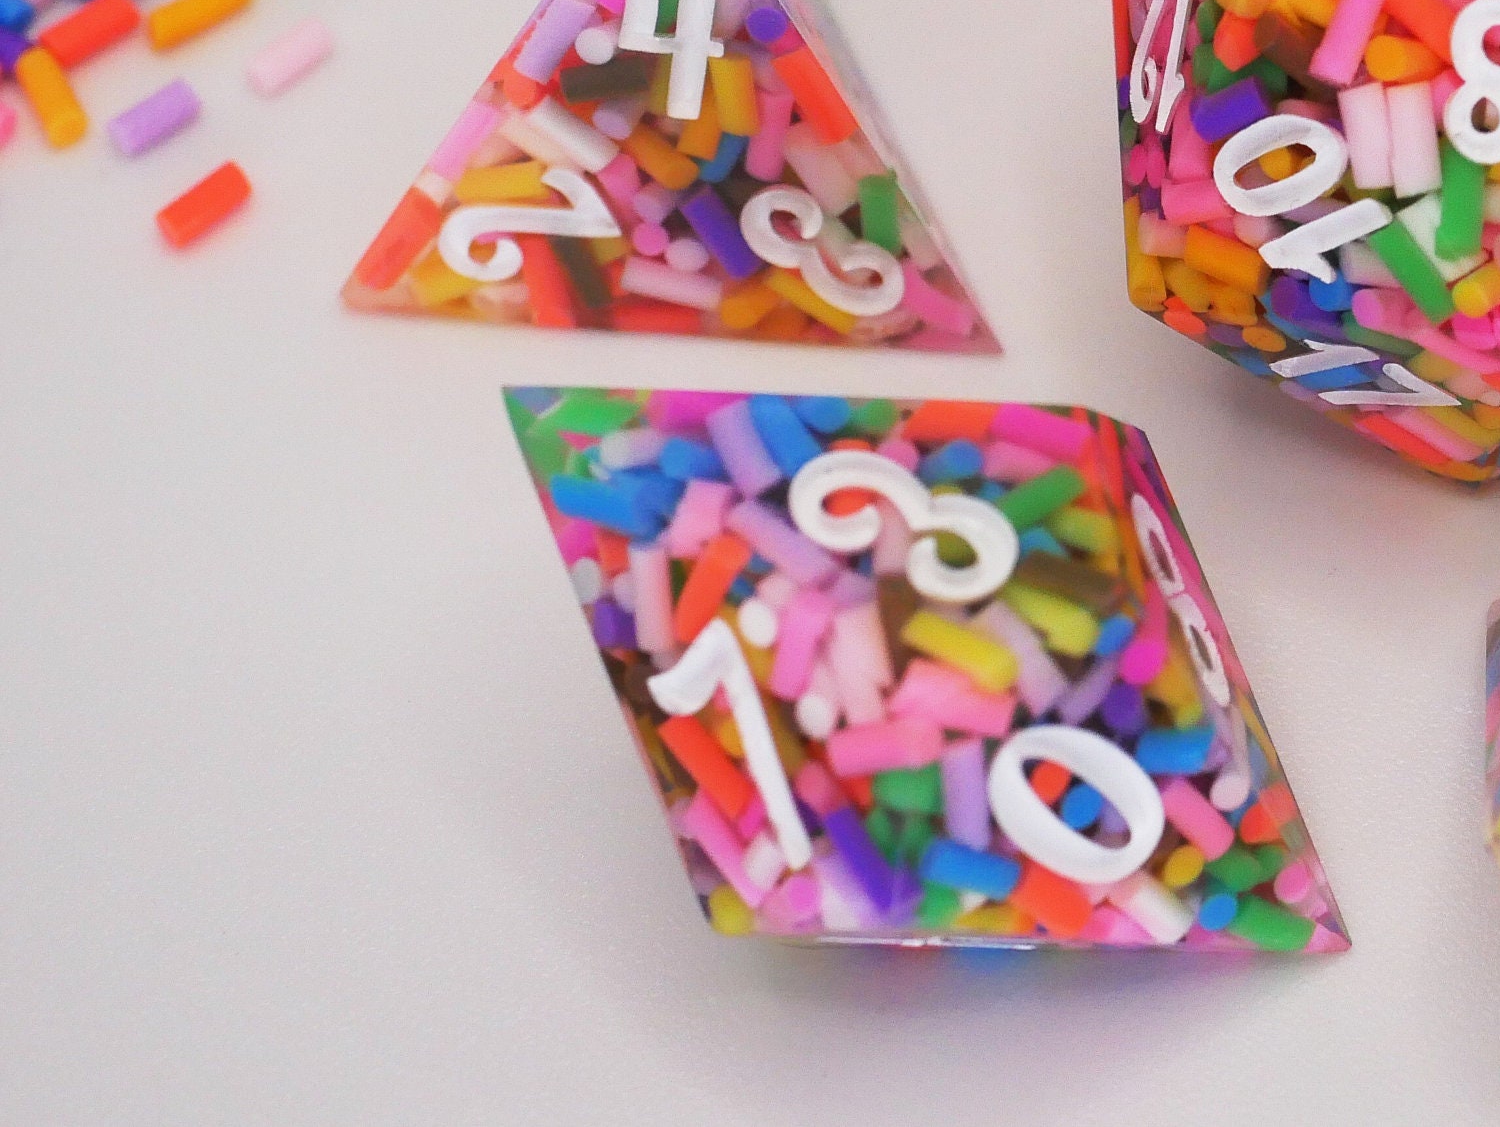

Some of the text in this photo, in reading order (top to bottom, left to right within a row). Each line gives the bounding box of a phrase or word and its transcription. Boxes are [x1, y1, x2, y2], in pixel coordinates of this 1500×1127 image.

[438, 169, 621, 281] 2
[740, 185, 905, 346] 3
[1213, 114, 1392, 283] 10
[1268, 338, 1462, 407] 17
[788, 450, 1019, 601] 3
[1131, 493, 1230, 707] 8
